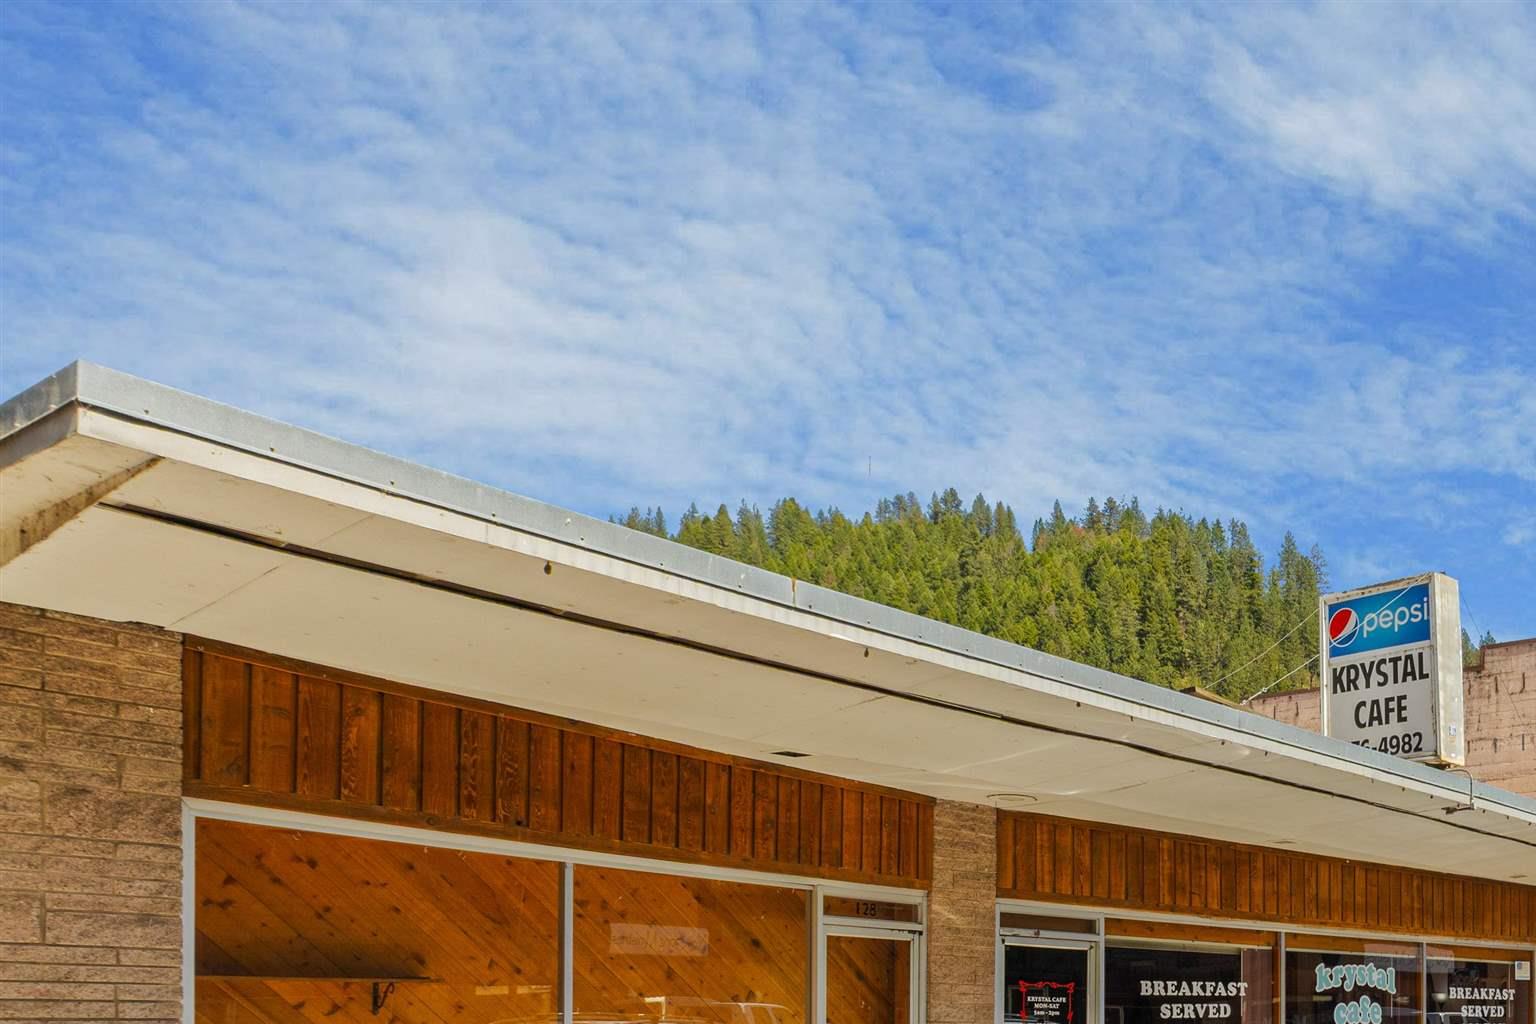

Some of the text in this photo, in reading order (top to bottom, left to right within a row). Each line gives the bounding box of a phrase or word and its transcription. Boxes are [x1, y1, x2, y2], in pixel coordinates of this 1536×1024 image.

[1362, 597, 1428, 638] pepsi
[1332, 652, 1430, 694] KRYSTAL
[1354, 695, 1408, 728] CAFE
[856, 902, 877, 916] 128
[1315, 962, 1397, 994] krystal
[1140, 980, 1248, 997] BREAKFAST
[1449, 986, 1516, 1001] BREAKFAST
[1160, 1003, 1232, 1019] SERVED
[1461, 1004, 1505, 1018] SERVED
